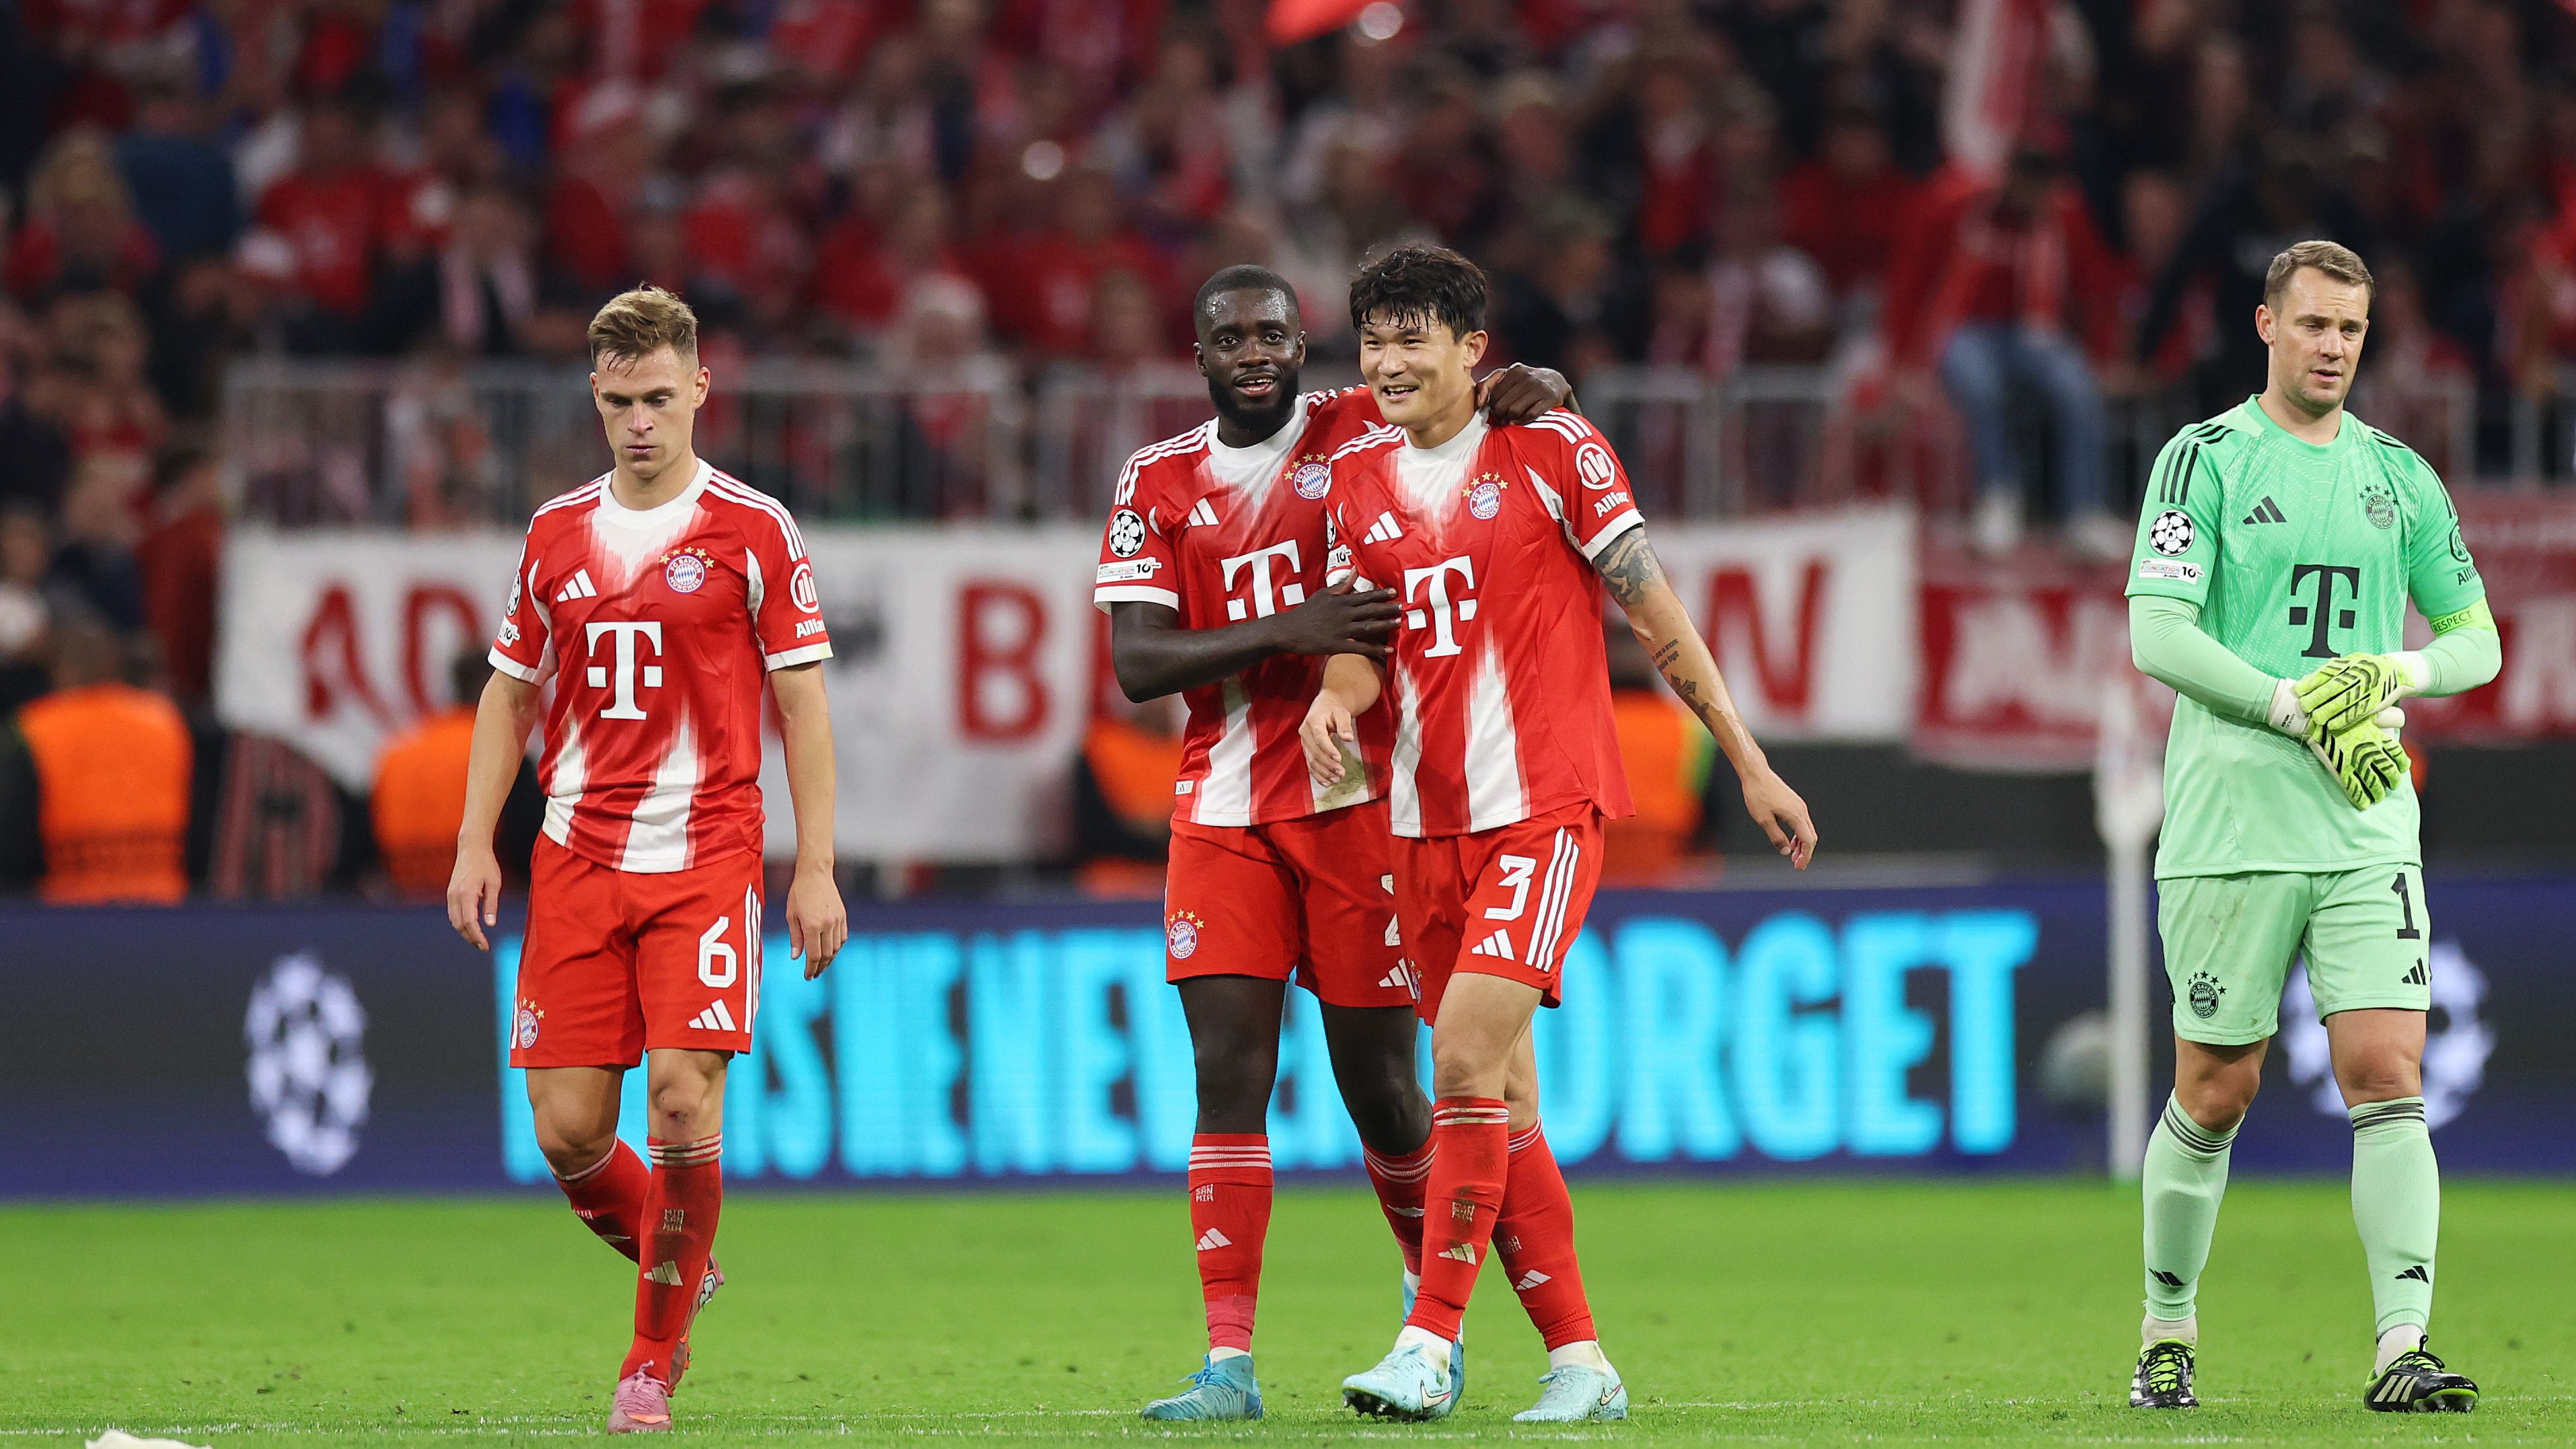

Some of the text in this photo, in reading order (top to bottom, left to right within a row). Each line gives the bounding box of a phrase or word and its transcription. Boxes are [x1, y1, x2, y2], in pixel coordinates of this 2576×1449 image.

[1404, 555, 1477, 658] T
[2457, 566, 2477, 585] Allia
[795, 618, 825, 638] Allia
[2289, 564, 2360, 658] T
[2433, 610, 2472, 633] RESPECT
[585, 622, 663, 720] T
[1484, 854, 1537, 921] 3
[2391, 872, 2420, 939] 1
[698, 916, 737, 988] 6
[1531, 911, 2039, 1164] ORGET
